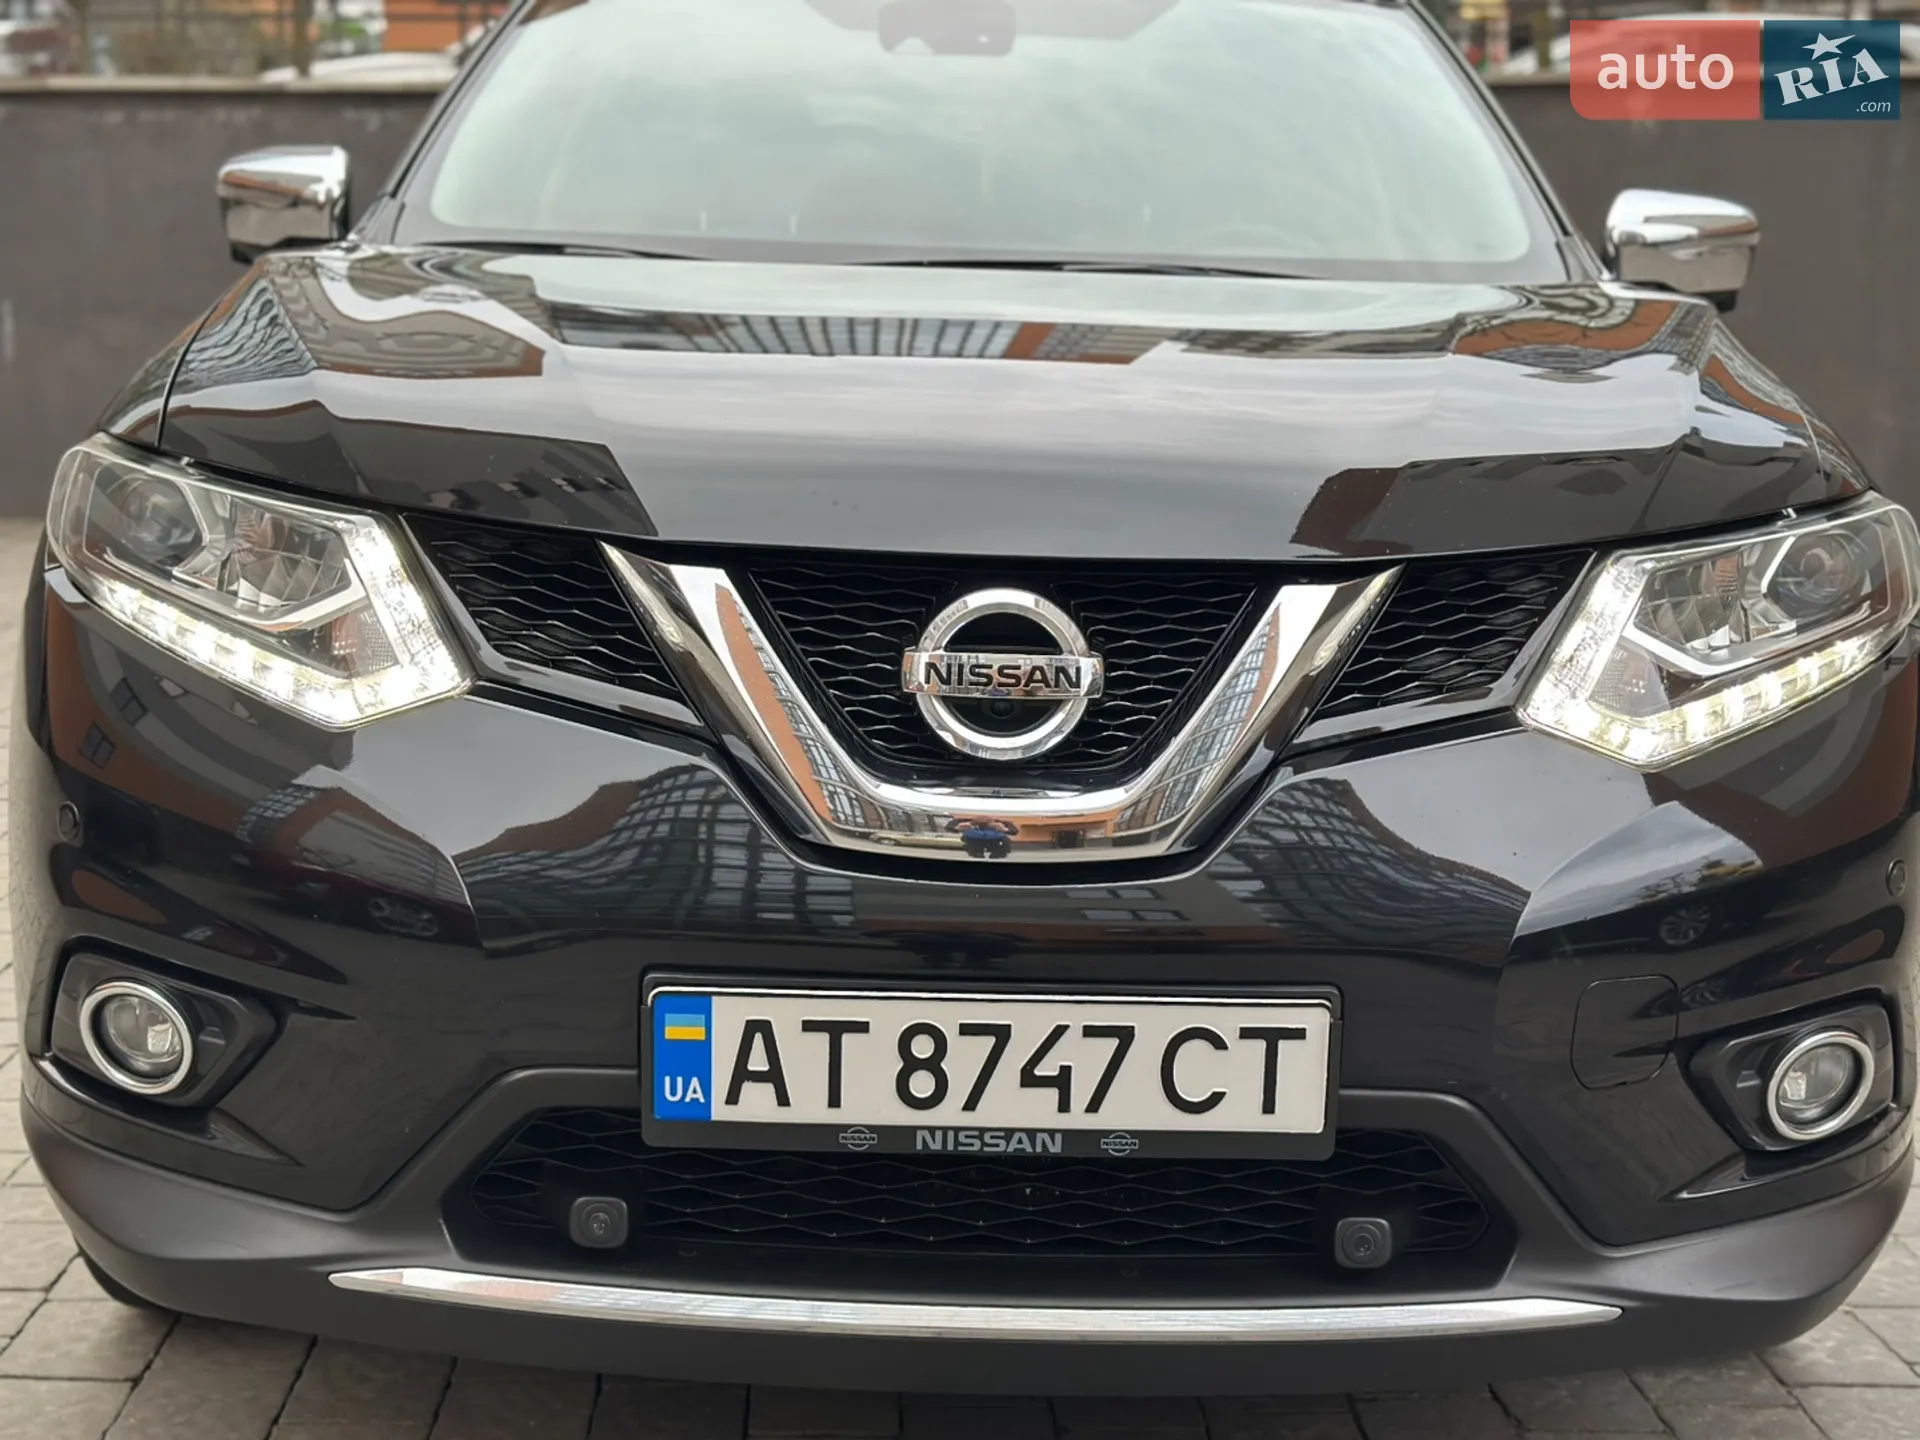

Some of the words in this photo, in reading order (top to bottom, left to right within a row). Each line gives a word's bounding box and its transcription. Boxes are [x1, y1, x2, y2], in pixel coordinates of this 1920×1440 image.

[924, 661, 1082, 689] NISSAN
[724, 1019, 870, 1109] AT
[895, 1022, 1136, 1113] 8747
[1160, 1026, 1307, 1114] CT
[664, 1076, 706, 1103] UA
[841, 1134, 876, 1142] NISSAN
[915, 1129, 1062, 1153] NISSAN
[1102, 1139, 1137, 1148] NISSAN
